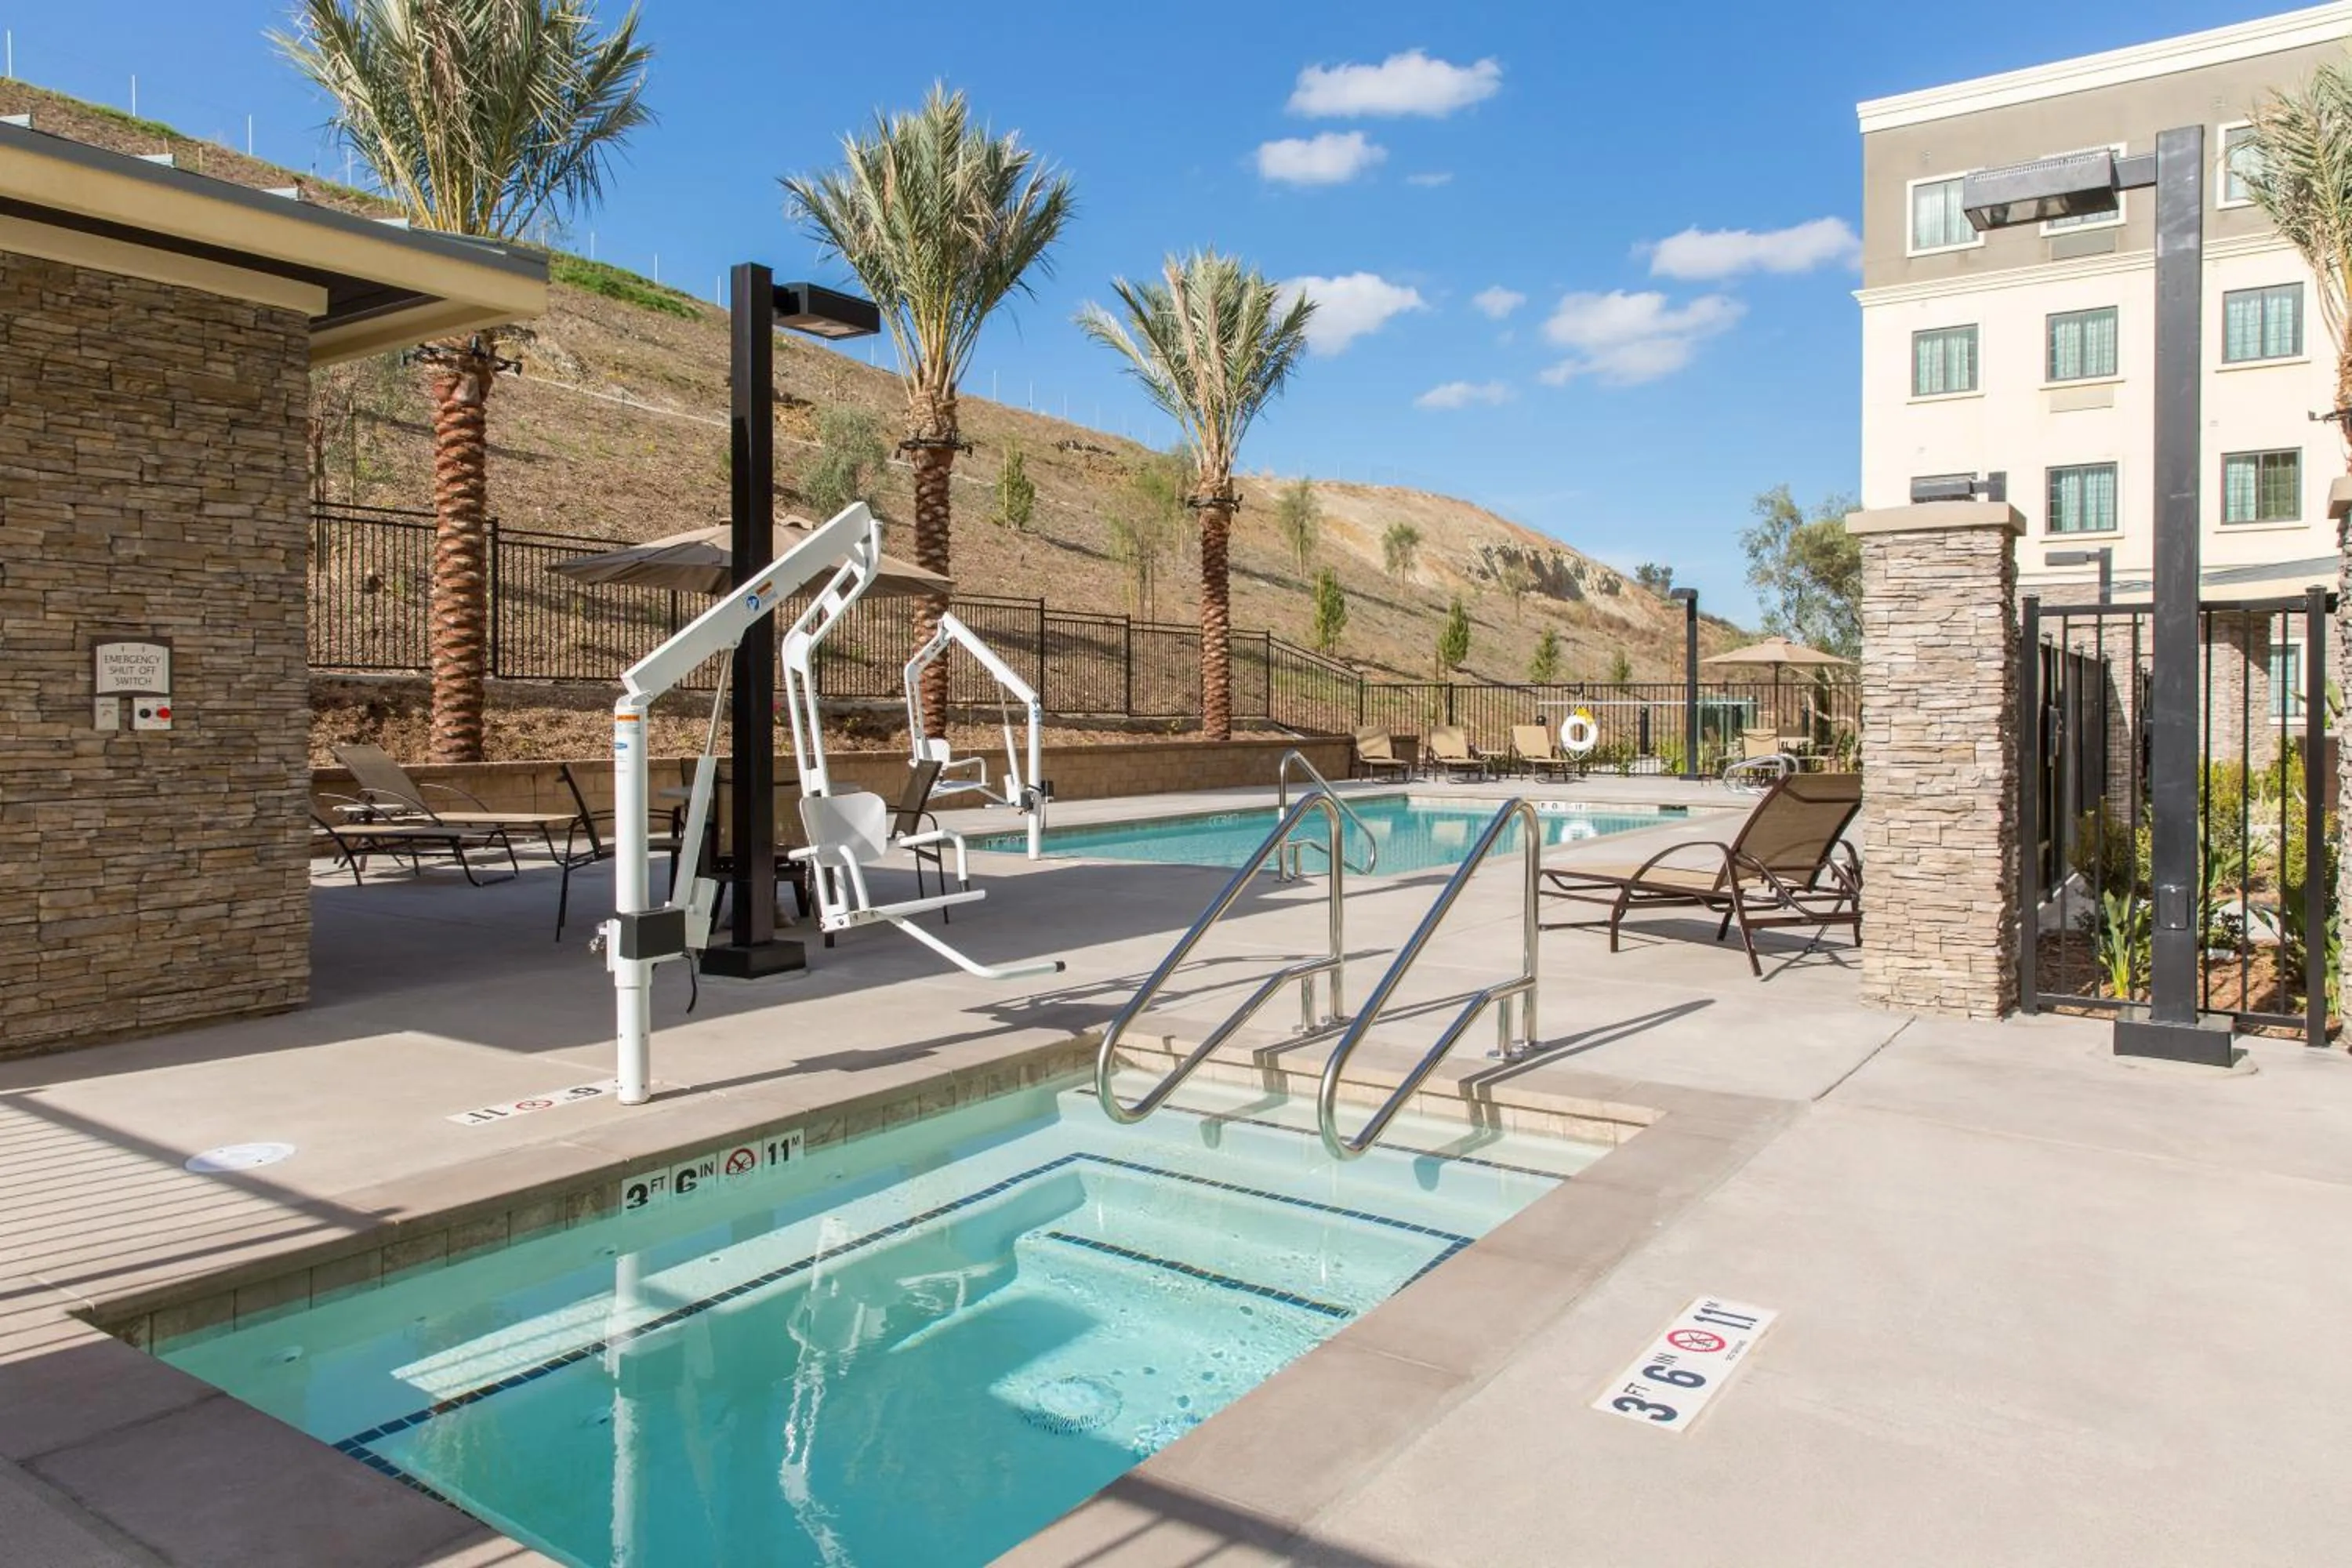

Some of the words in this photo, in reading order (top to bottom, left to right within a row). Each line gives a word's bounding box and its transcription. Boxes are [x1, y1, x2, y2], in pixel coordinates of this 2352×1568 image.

[104, 655, 161, 664] EMERGENCY
[108, 666, 135, 675] SHUT
[138, 666, 156, 675] OFF
[114, 677, 152, 686] SWITCH
[626, 1183, 648, 1209] 3
[650, 1175, 666, 1194] FT
[699, 1161, 714, 1178] IN
[1642, 1365, 1707, 1388] 6
[1622, 1382, 1650, 1397] FT
[1612, 1396, 1679, 1421] 3
